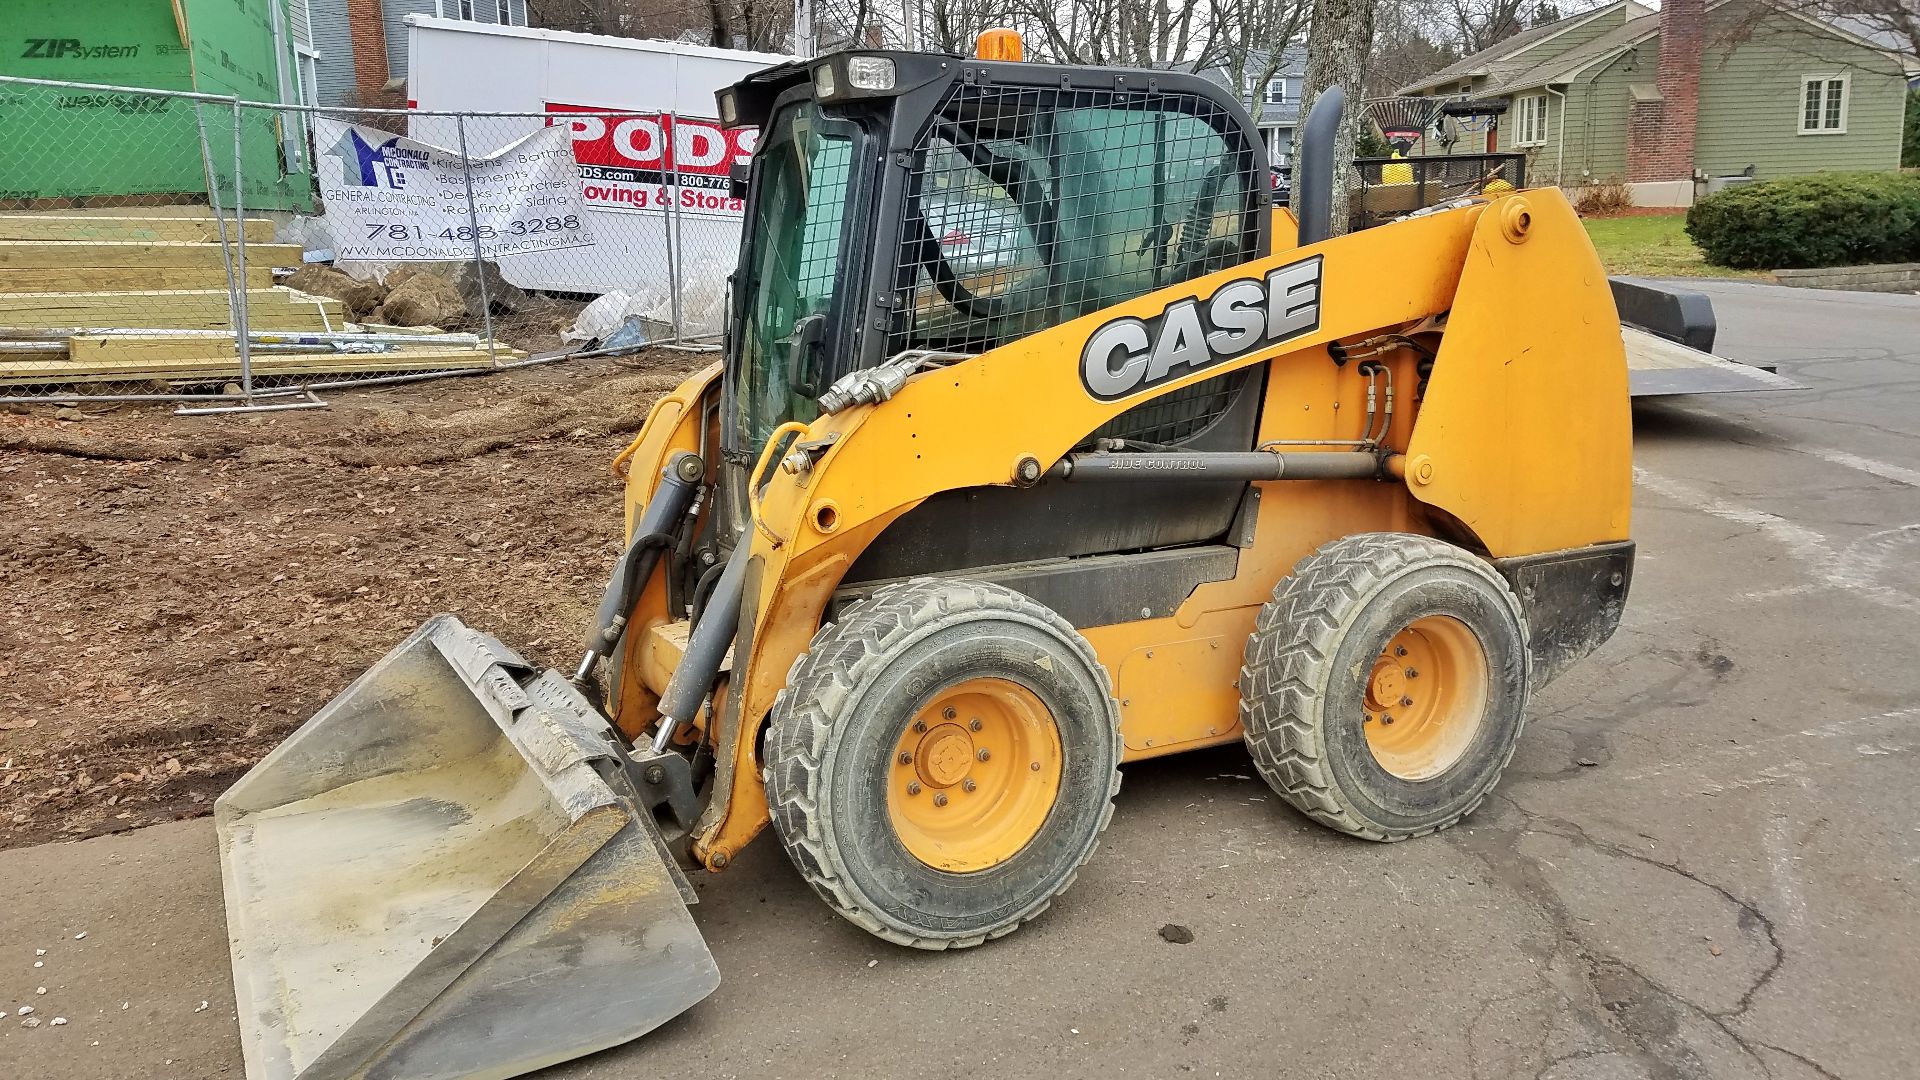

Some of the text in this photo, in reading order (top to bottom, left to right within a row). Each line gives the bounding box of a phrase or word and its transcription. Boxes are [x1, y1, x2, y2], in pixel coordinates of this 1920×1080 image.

[381, 146, 430, 161] MCDONALD
[383, 157, 430, 171] CONTRACTING
[440, 170, 528, 185] Basements
[507, 179, 567, 196] Porches
[582, 183, 648, 208] oving
[655, 187, 673, 207] &
[326, 189, 436, 207] GENERAL CONTRACTING
[526, 195, 567, 208] Siding
[365, 214, 580, 242] 781-488-3288
[1081, 257, 1321, 397] CASE
[1108, 458, 1207, 470] RIDE CONTROL
[886, 891, 1036, 929] GALAXY
